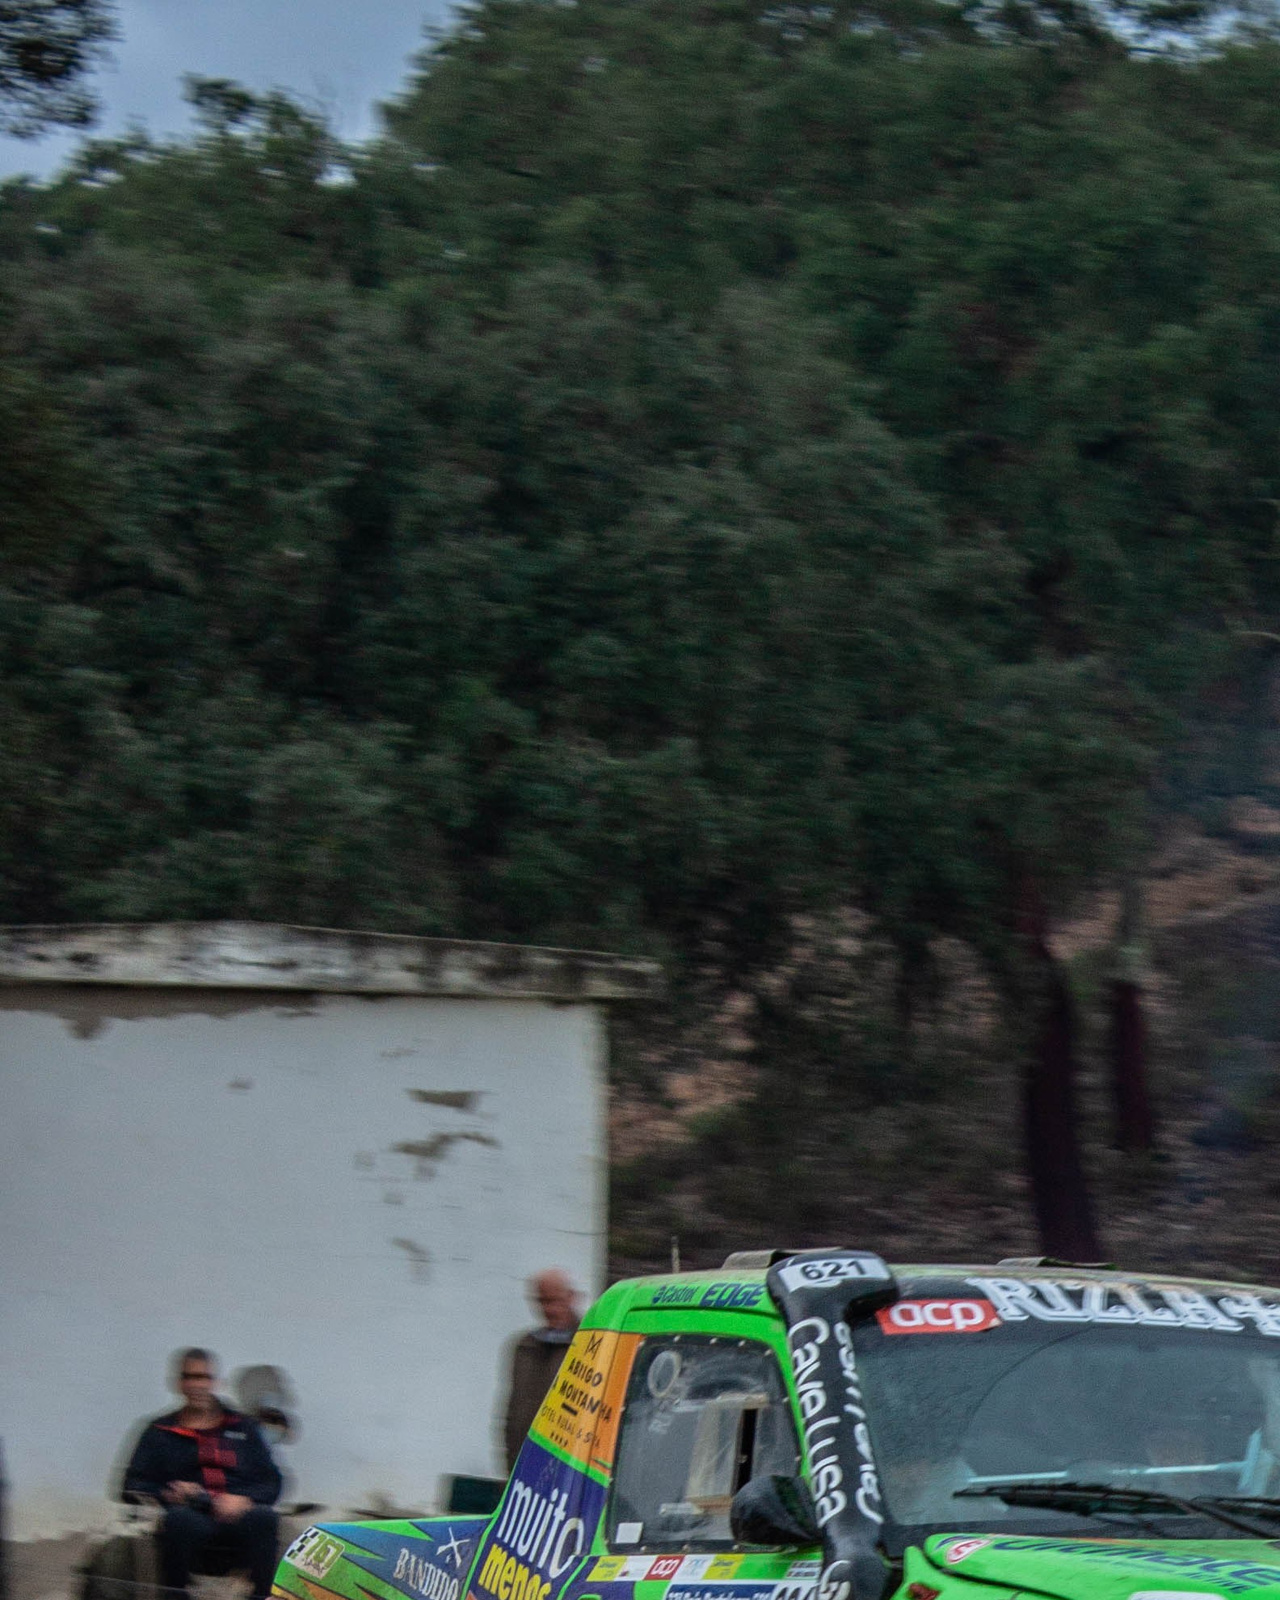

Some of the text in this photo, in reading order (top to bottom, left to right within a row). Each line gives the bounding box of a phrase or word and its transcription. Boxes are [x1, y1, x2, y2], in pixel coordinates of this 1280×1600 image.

[801, 1260, 867, 1281] 621
[661, 1282, 767, 1307] Castrol EDGE
[889, 1301, 985, 1329] acp
[496, 1478, 585, 1579] muito
[651, 1558, 680, 1577] acp
